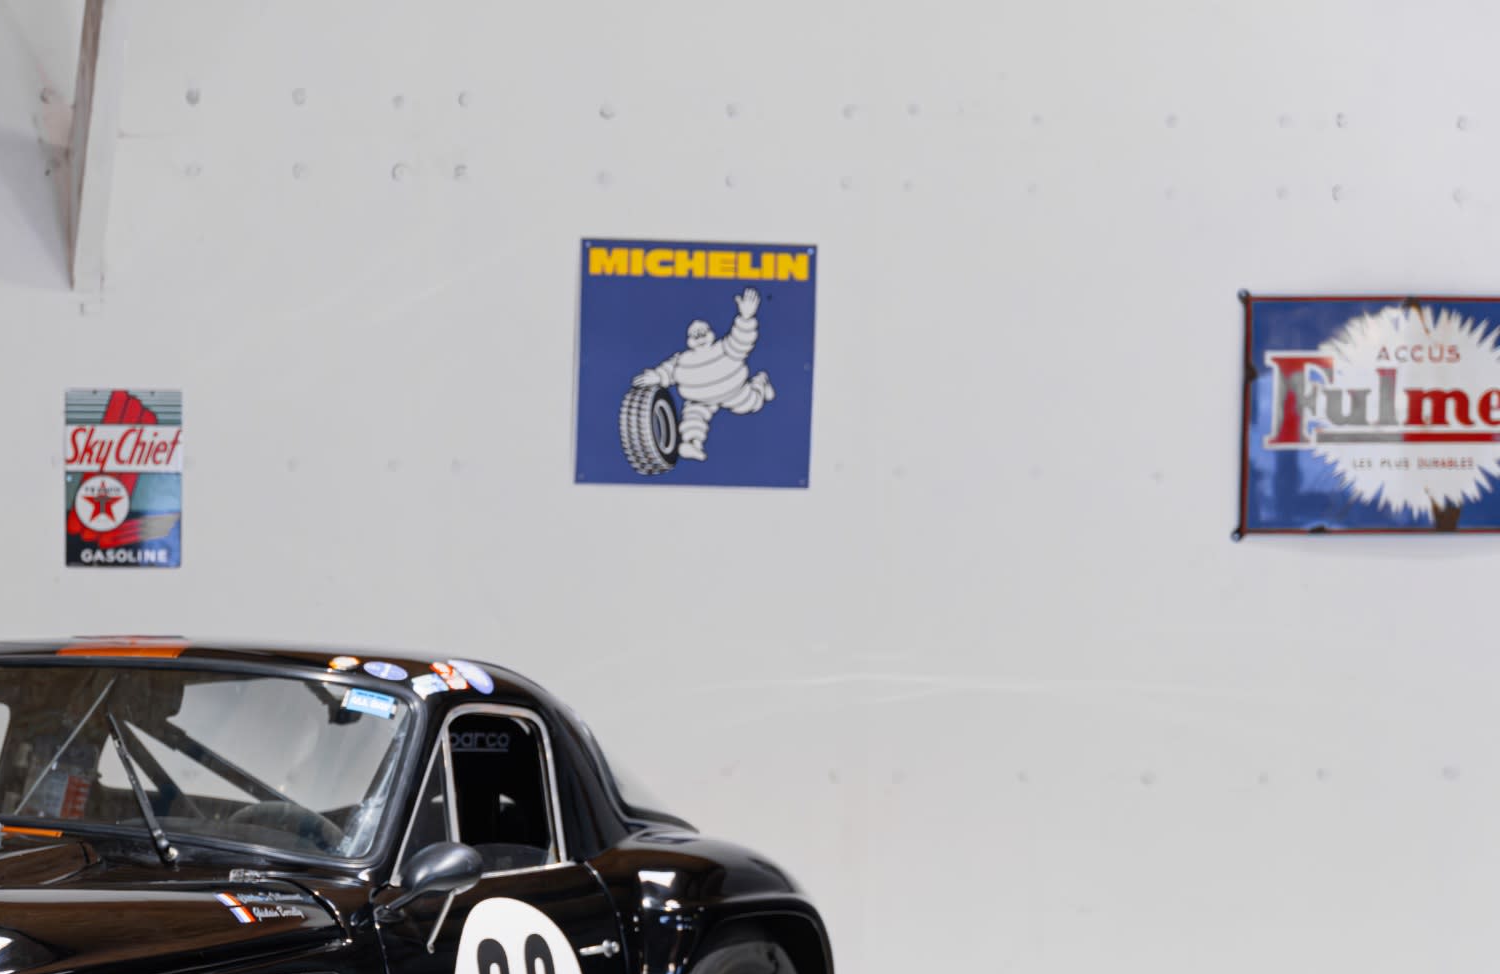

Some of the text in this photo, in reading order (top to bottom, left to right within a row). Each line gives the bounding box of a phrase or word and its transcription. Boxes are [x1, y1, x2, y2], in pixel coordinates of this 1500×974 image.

[589, 247, 810, 281] MICHELIN
[1376, 344, 1462, 364] ACCUS
[65, 425, 182, 474] Sky Chief
[80, 549, 169, 563] GASOLINE
